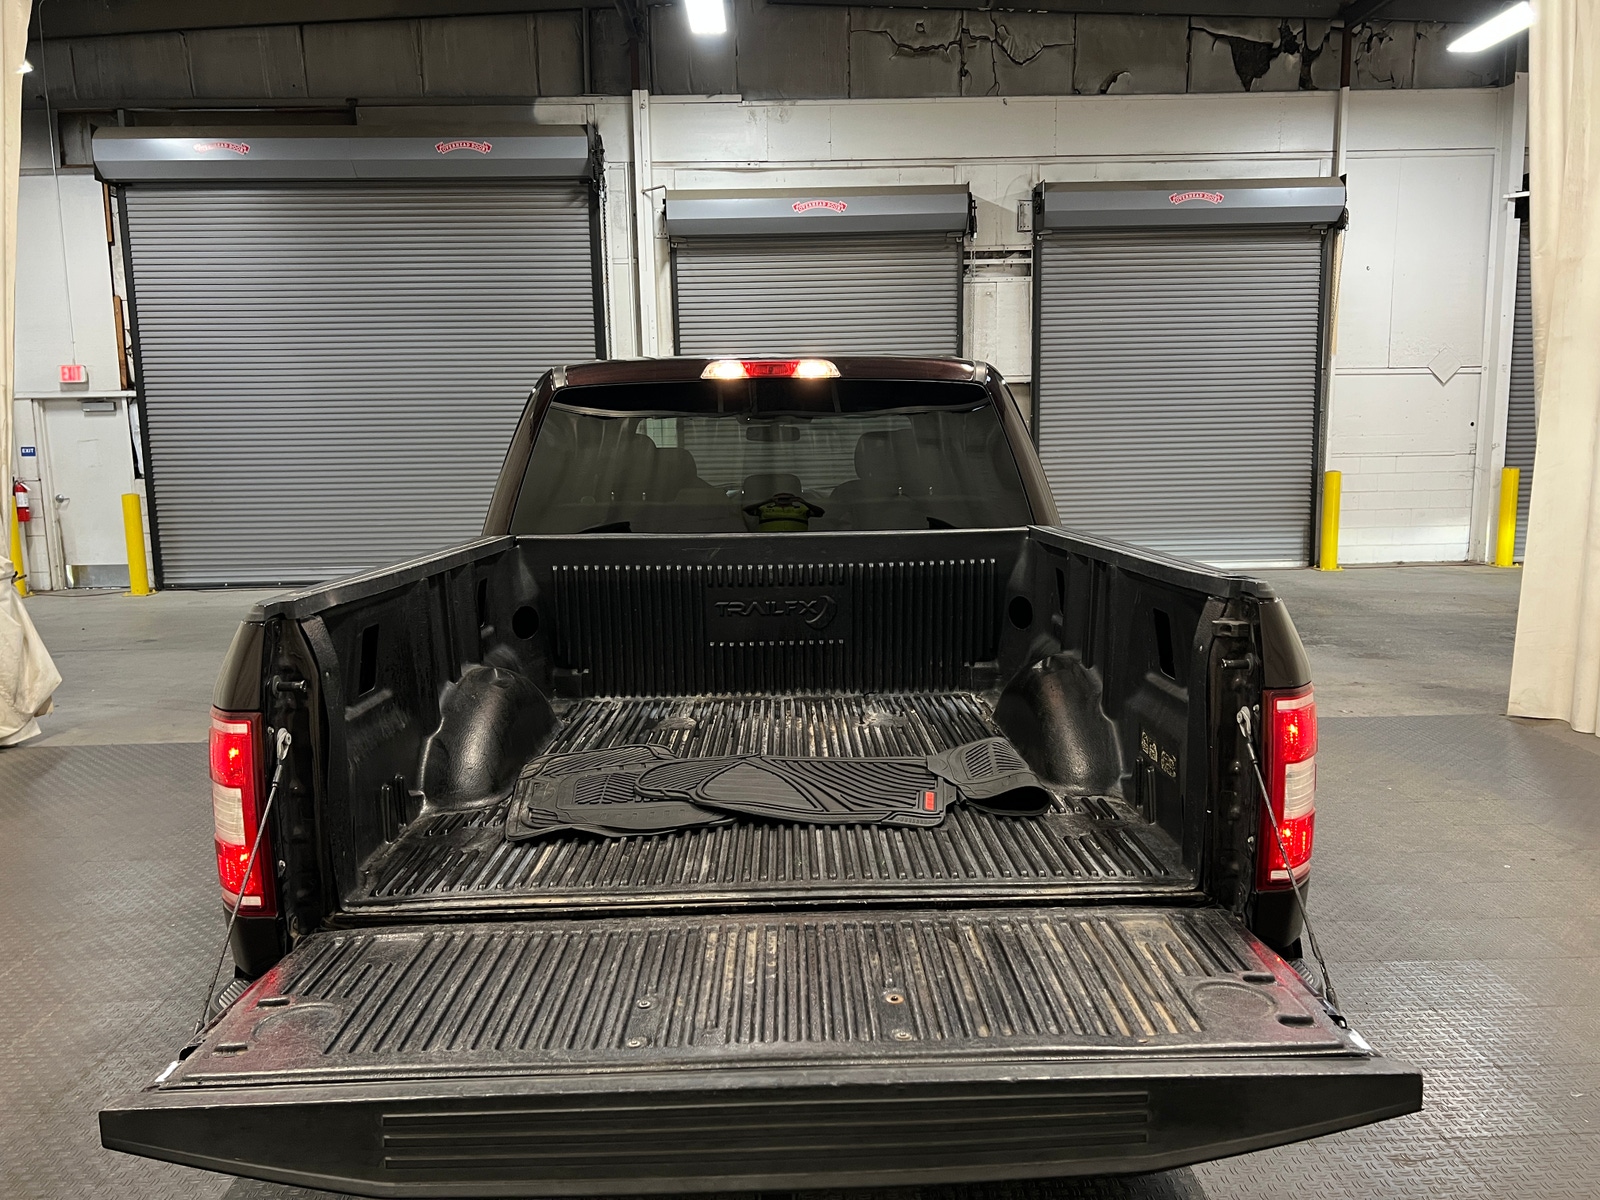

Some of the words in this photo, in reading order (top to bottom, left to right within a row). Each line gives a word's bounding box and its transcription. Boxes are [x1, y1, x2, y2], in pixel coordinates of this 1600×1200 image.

[441, 142, 470, 152] OVERHEAD
[471, 143, 487, 152] DOOR
[1174, 193, 1203, 203] OVERHEAD
[1204, 193, 1219, 203] DOOR
[797, 201, 826, 212] OVERHEAD
[828, 202, 842, 212] DOOR
[61, 366, 82, 381] EXIT
[714, 600, 818, 617] TRAILFX
